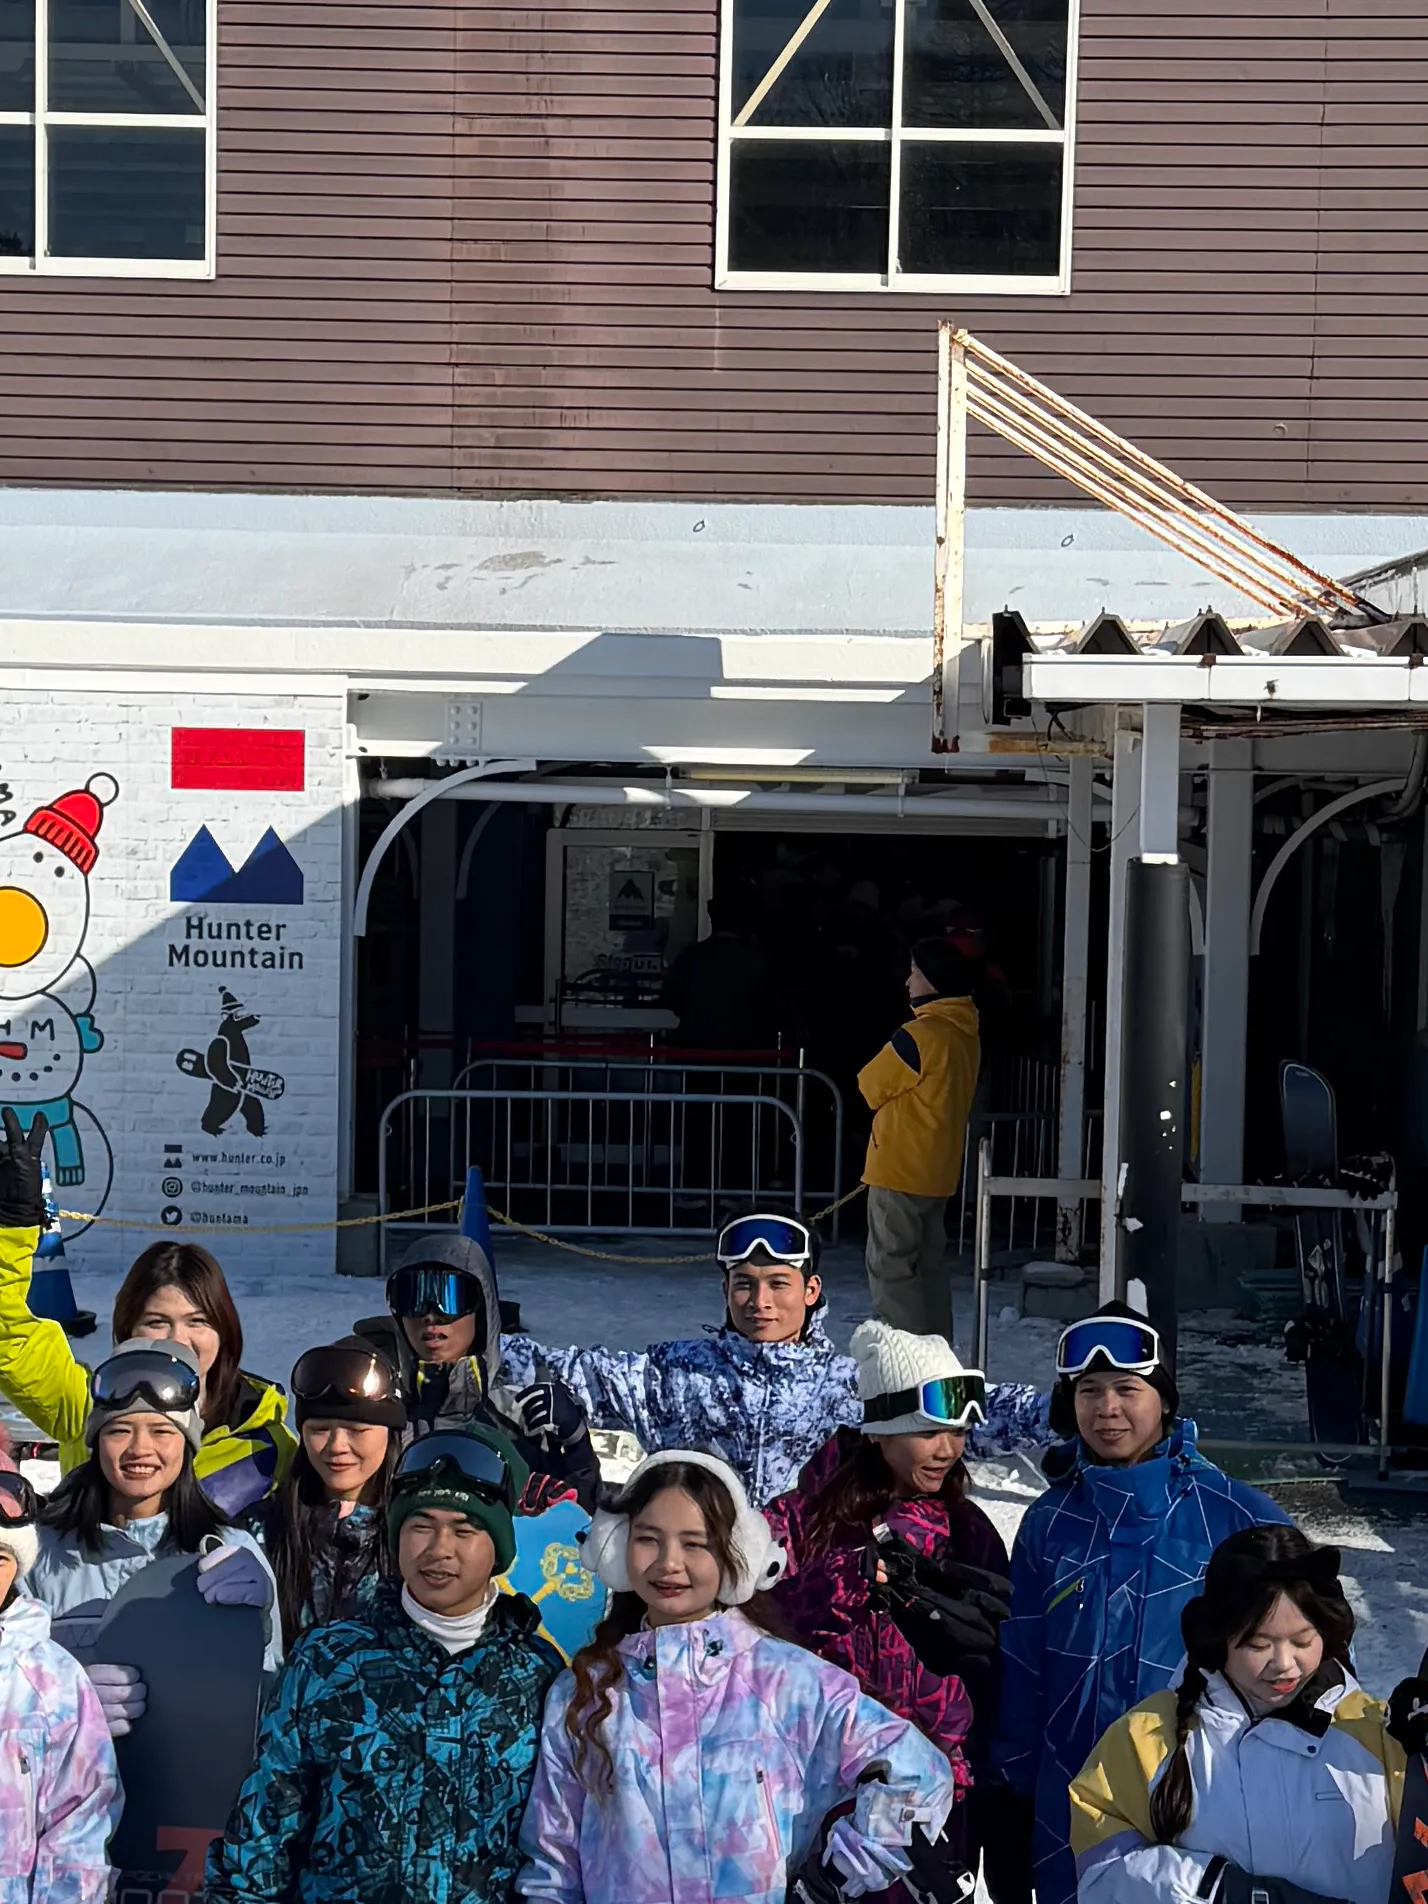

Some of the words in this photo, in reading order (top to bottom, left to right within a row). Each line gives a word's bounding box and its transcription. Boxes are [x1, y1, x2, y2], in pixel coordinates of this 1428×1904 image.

[184, 915, 287, 941] Hunter
[167, 943, 304, 970] Mountain
[192, 1152, 286, 1168] www.hunter.co.jp
